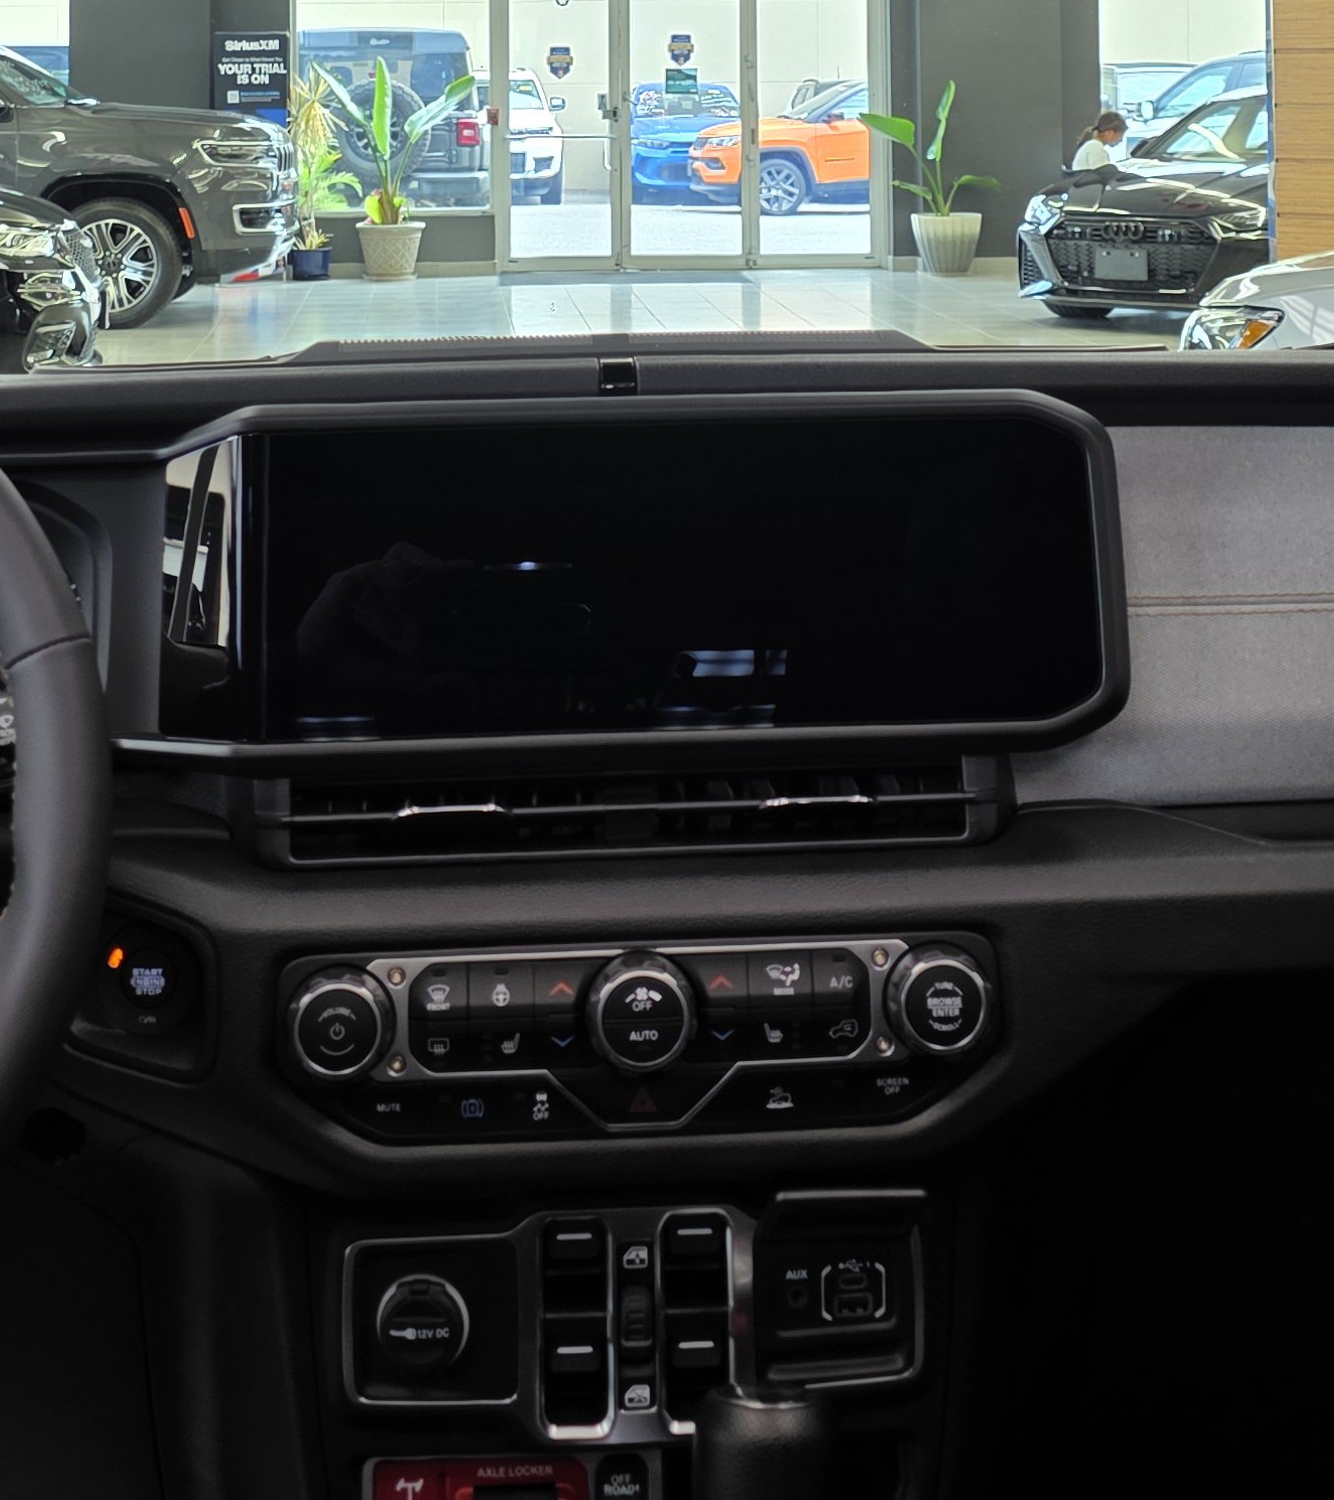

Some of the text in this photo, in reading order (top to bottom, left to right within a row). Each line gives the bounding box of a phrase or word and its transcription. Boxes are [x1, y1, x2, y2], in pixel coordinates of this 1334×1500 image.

[225, 40, 280, 51] SiriusXM
[218, 63, 287, 74] YOUR TRIAL
[237, 74, 270, 84] IS ON
[132, 968, 164, 976] START
[829, 975, 854, 989] A/C
[135, 987, 162, 996] STOP
[631, 1000, 653, 1012] OFF
[926, 996, 963, 1008] BROWSE
[931, 1007, 961, 1018] ENTER
[629, 1030, 659, 1042] AUTO
[876, 1076, 910, 1086] SCREEN
[884, 1085, 900, 1096] OFF
[376, 1102, 401, 1113] MUTE
[532, 1110, 550, 1121] OFF
[785, 1268, 809, 1280] AUX
[417, 1327, 450, 1339] 12V DC
[476, 1464, 554, 1478] AXLE LOCKER
[610, 1473, 631, 1486] OFF
